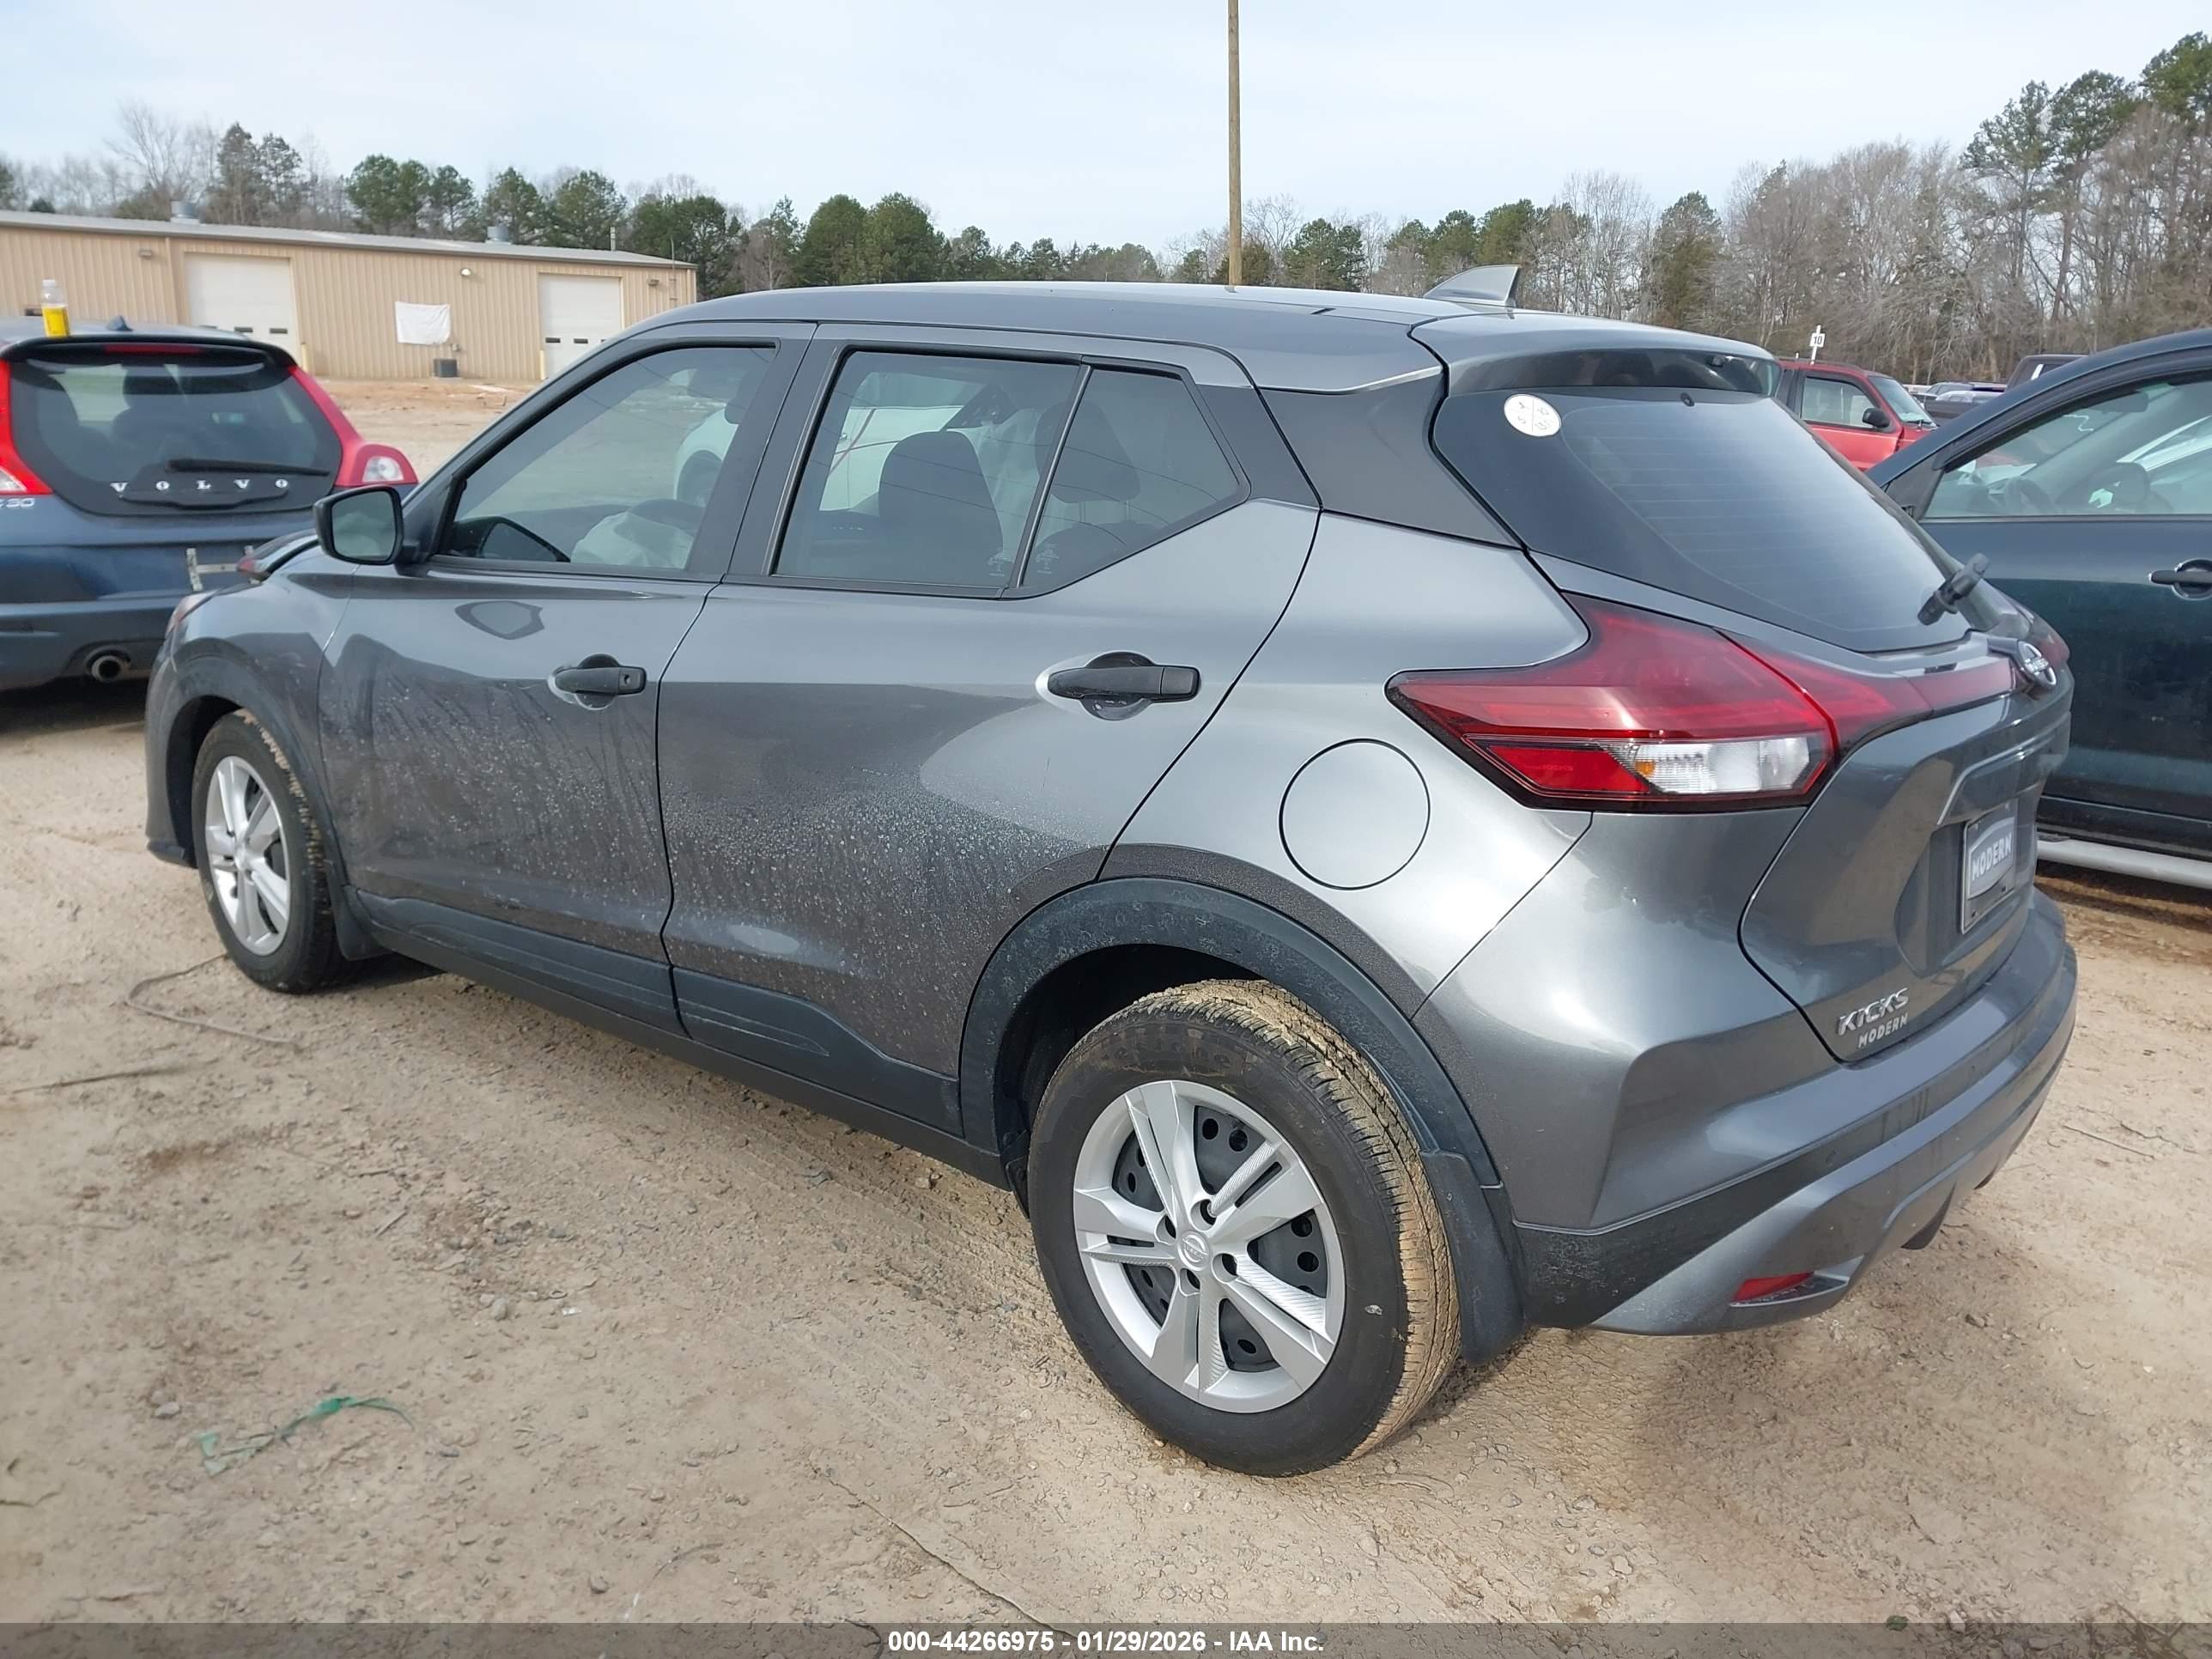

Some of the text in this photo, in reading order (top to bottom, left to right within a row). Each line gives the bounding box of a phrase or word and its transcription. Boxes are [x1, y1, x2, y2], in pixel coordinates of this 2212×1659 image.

[1814, 336, 1822, 344] 10
[110, 478, 289, 492] VOLVO
[1972, 831, 2012, 881] MODERN
[1838, 988, 1908, 1036] KICKS
[1858, 1012, 1908, 1048] MODERN
